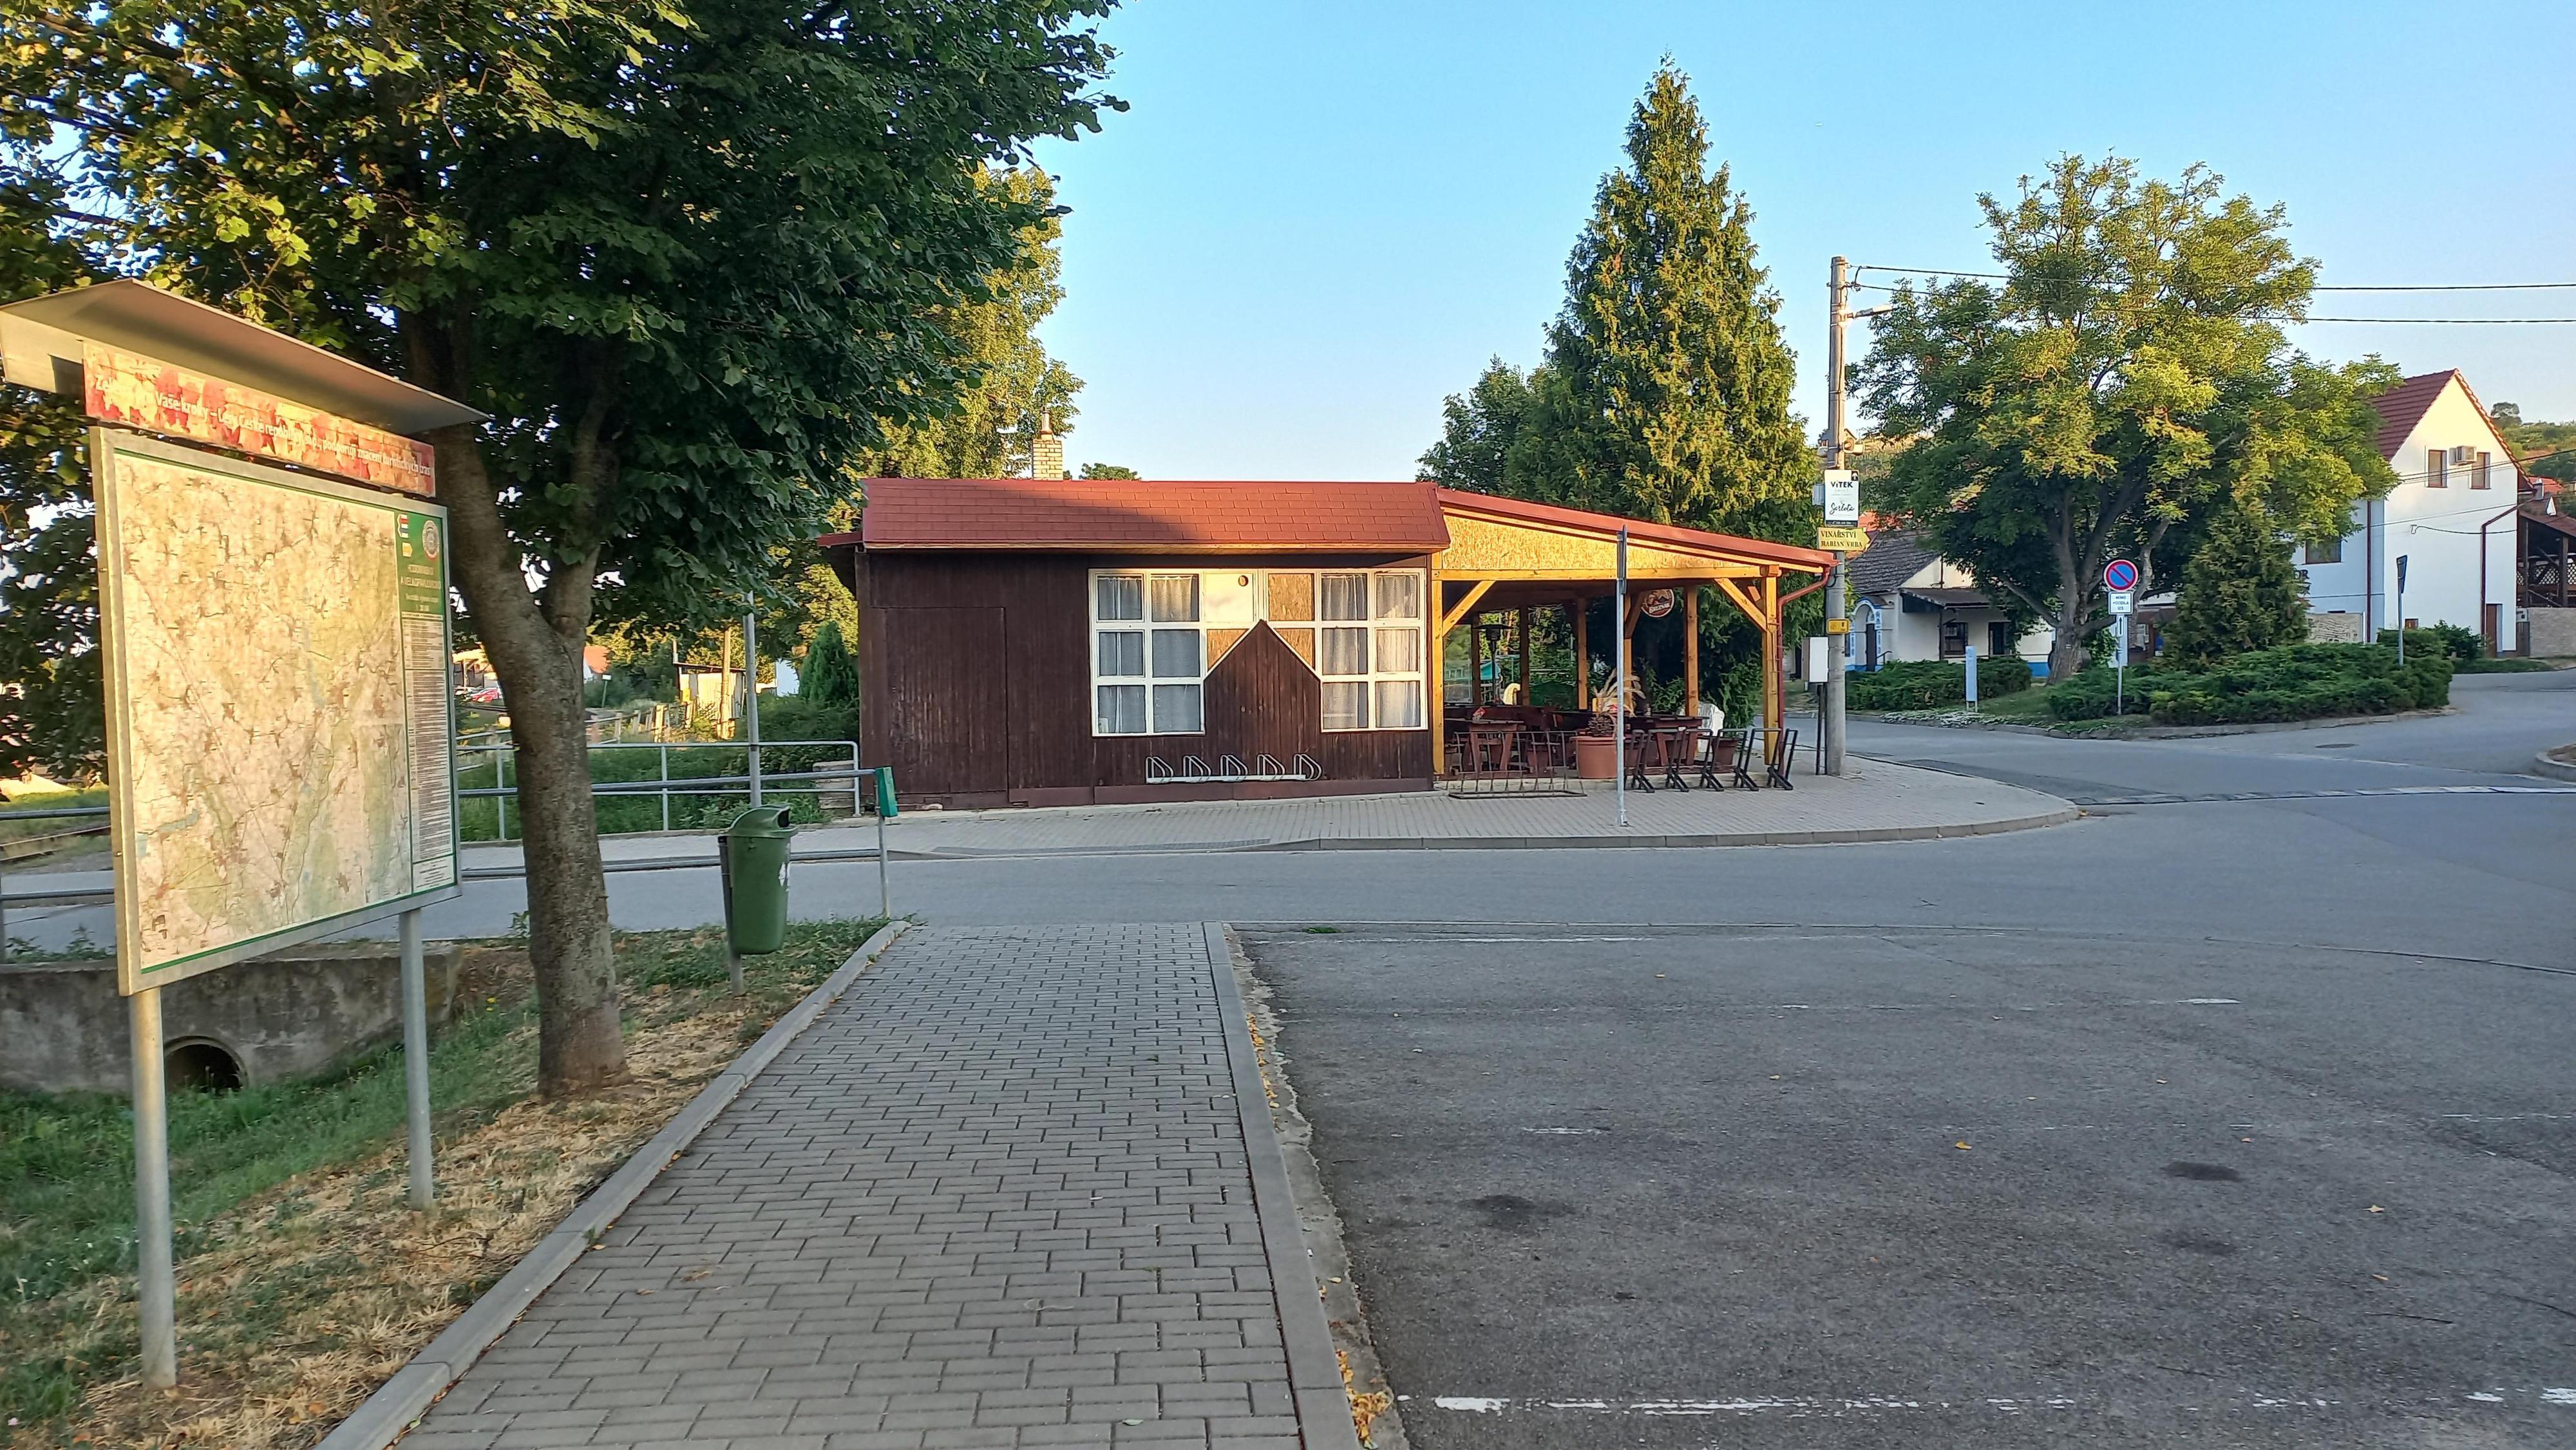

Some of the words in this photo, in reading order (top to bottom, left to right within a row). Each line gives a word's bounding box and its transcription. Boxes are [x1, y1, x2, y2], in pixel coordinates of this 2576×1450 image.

[155, 391, 180, 411] Vaše
[180, 395, 209, 422] kroky
[419, 463, 431, 476] tras
[1821, 530, 1857, 538] VINAŘSTVÍ
